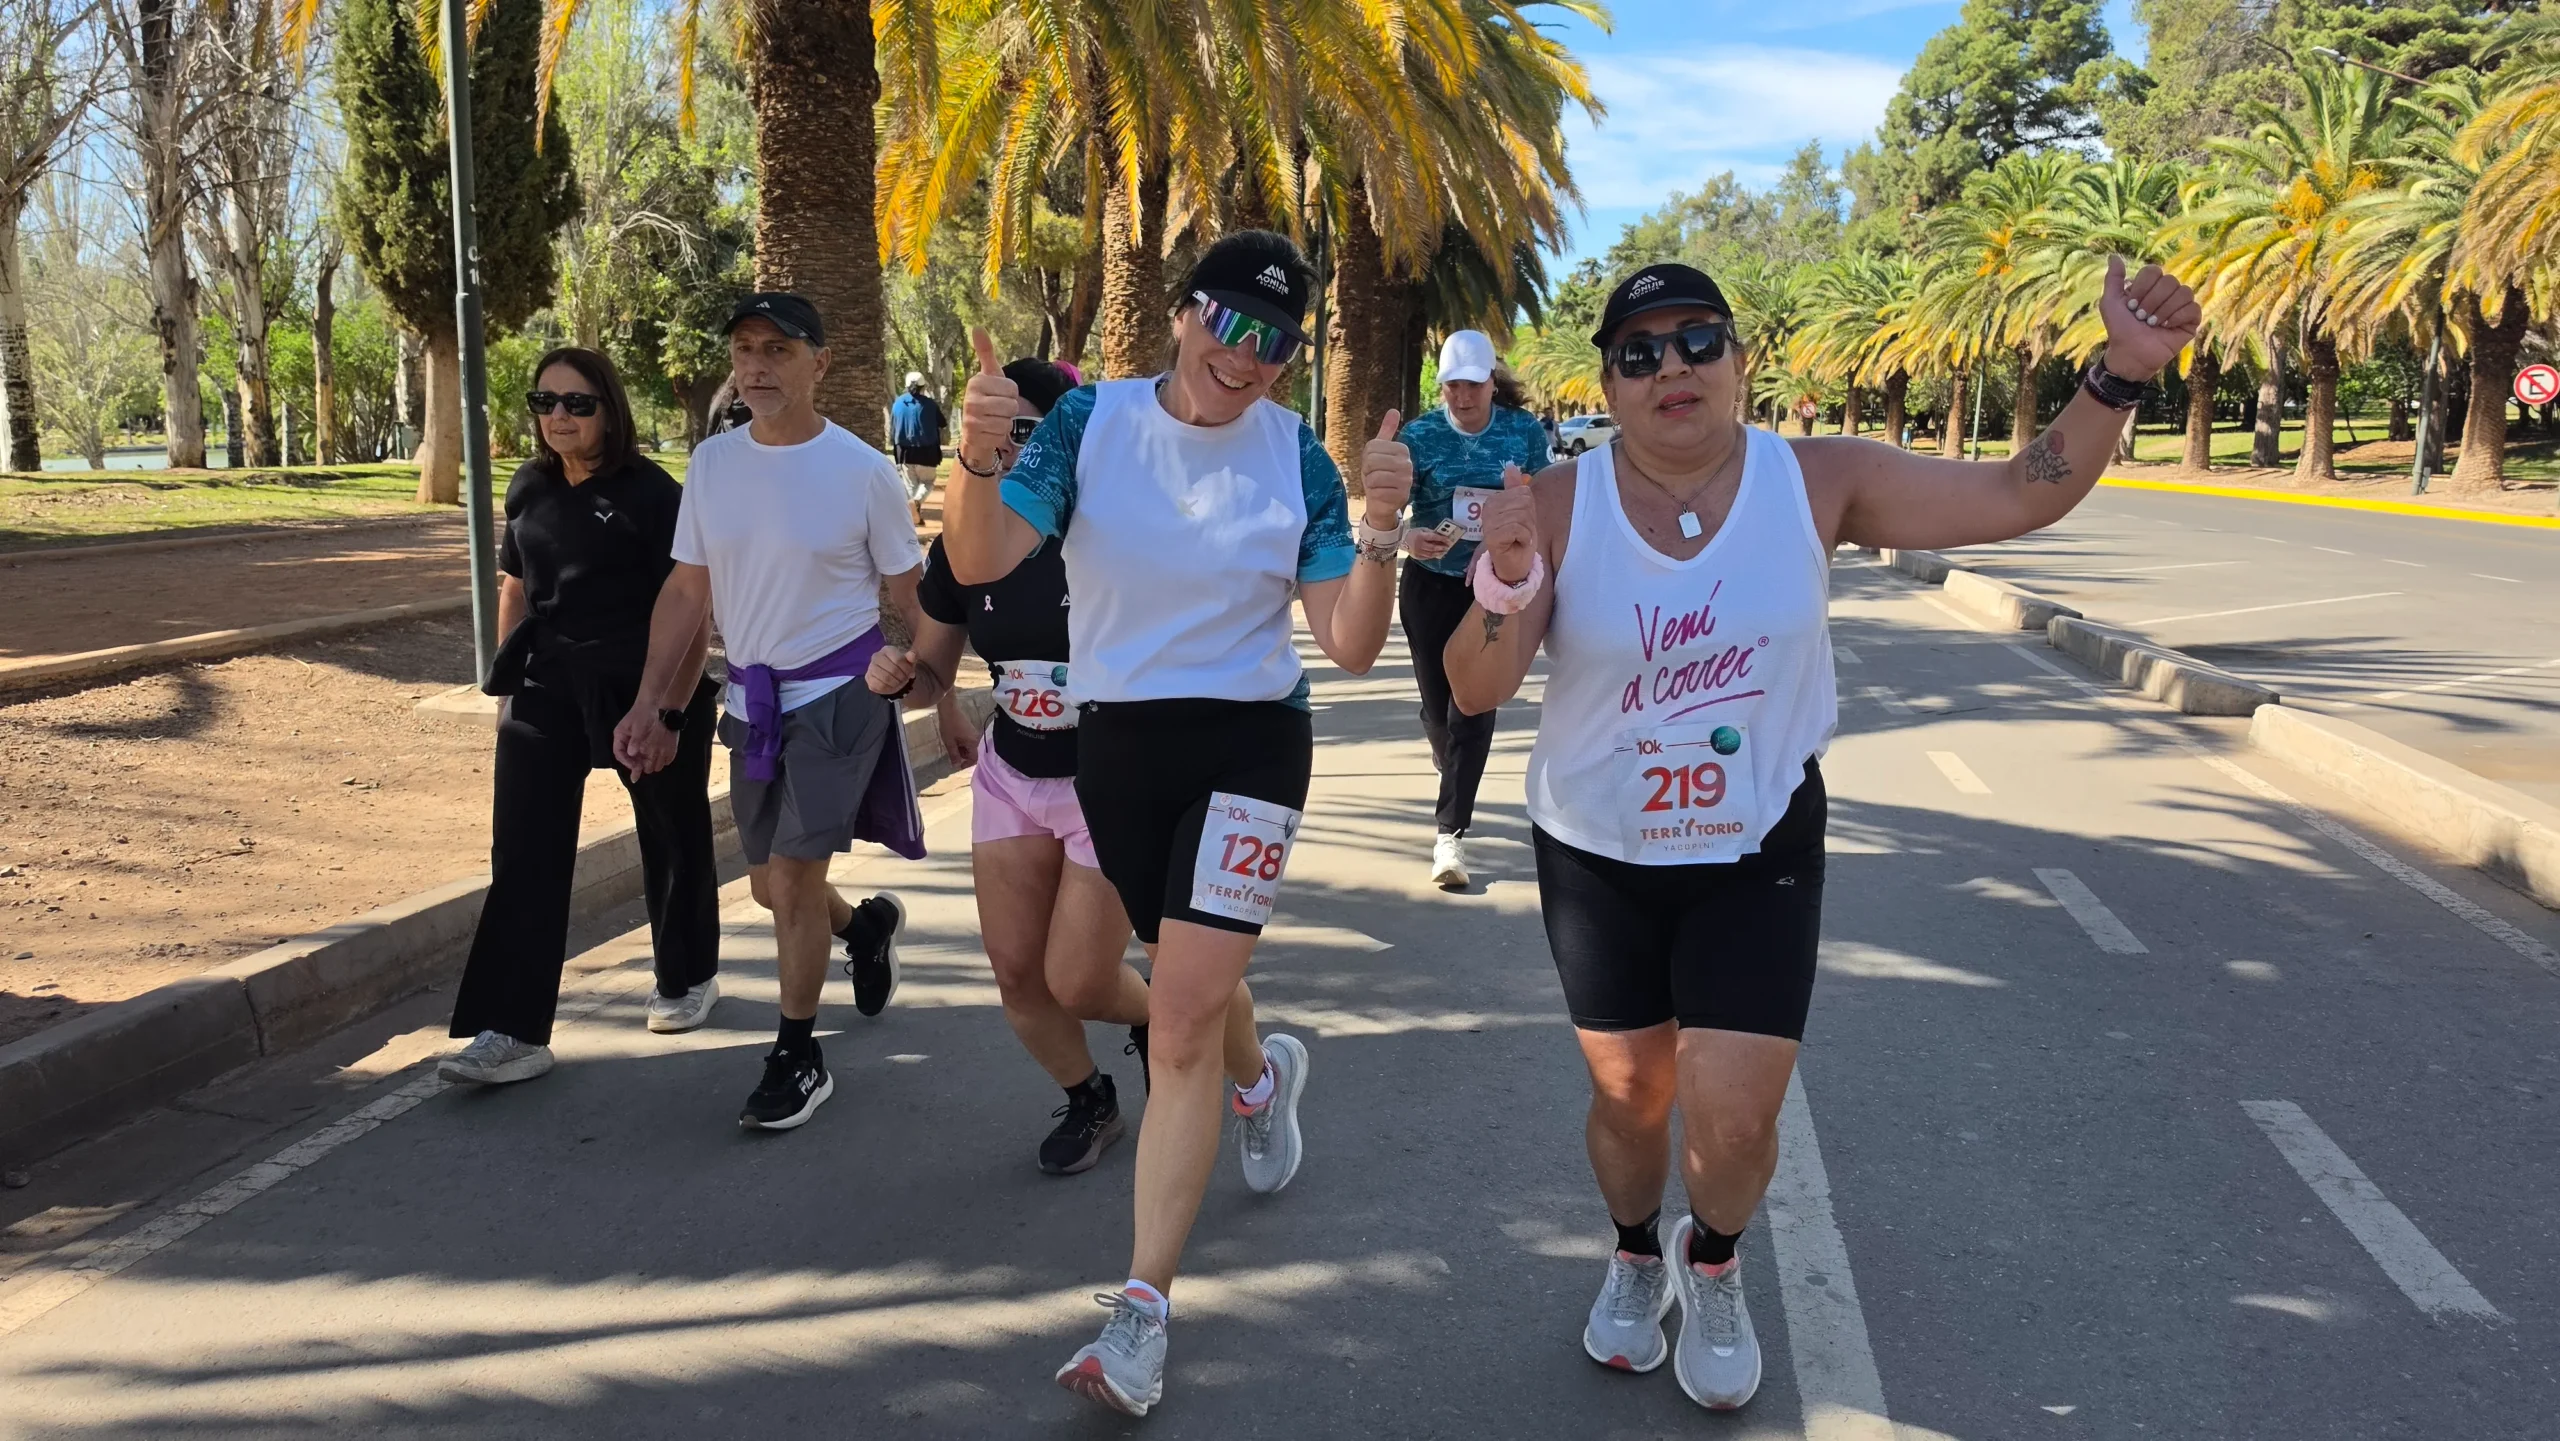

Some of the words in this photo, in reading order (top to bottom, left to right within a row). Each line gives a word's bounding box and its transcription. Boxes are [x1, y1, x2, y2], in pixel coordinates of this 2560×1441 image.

[1467, 502, 1482, 521] 9
[1009, 669, 1024, 680] 10k
[1004, 688, 1065, 717] 226
[1621, 674, 1644, 714] a
[1637, 739, 1664, 756] 10k
[1640, 762, 1726, 813] 219
[1228, 806, 1251, 823] 10k
[1219, 833, 1285, 881] 128
[1664, 842, 1715, 852] YACOPINI
[799, 1068, 818, 1095] FILA
